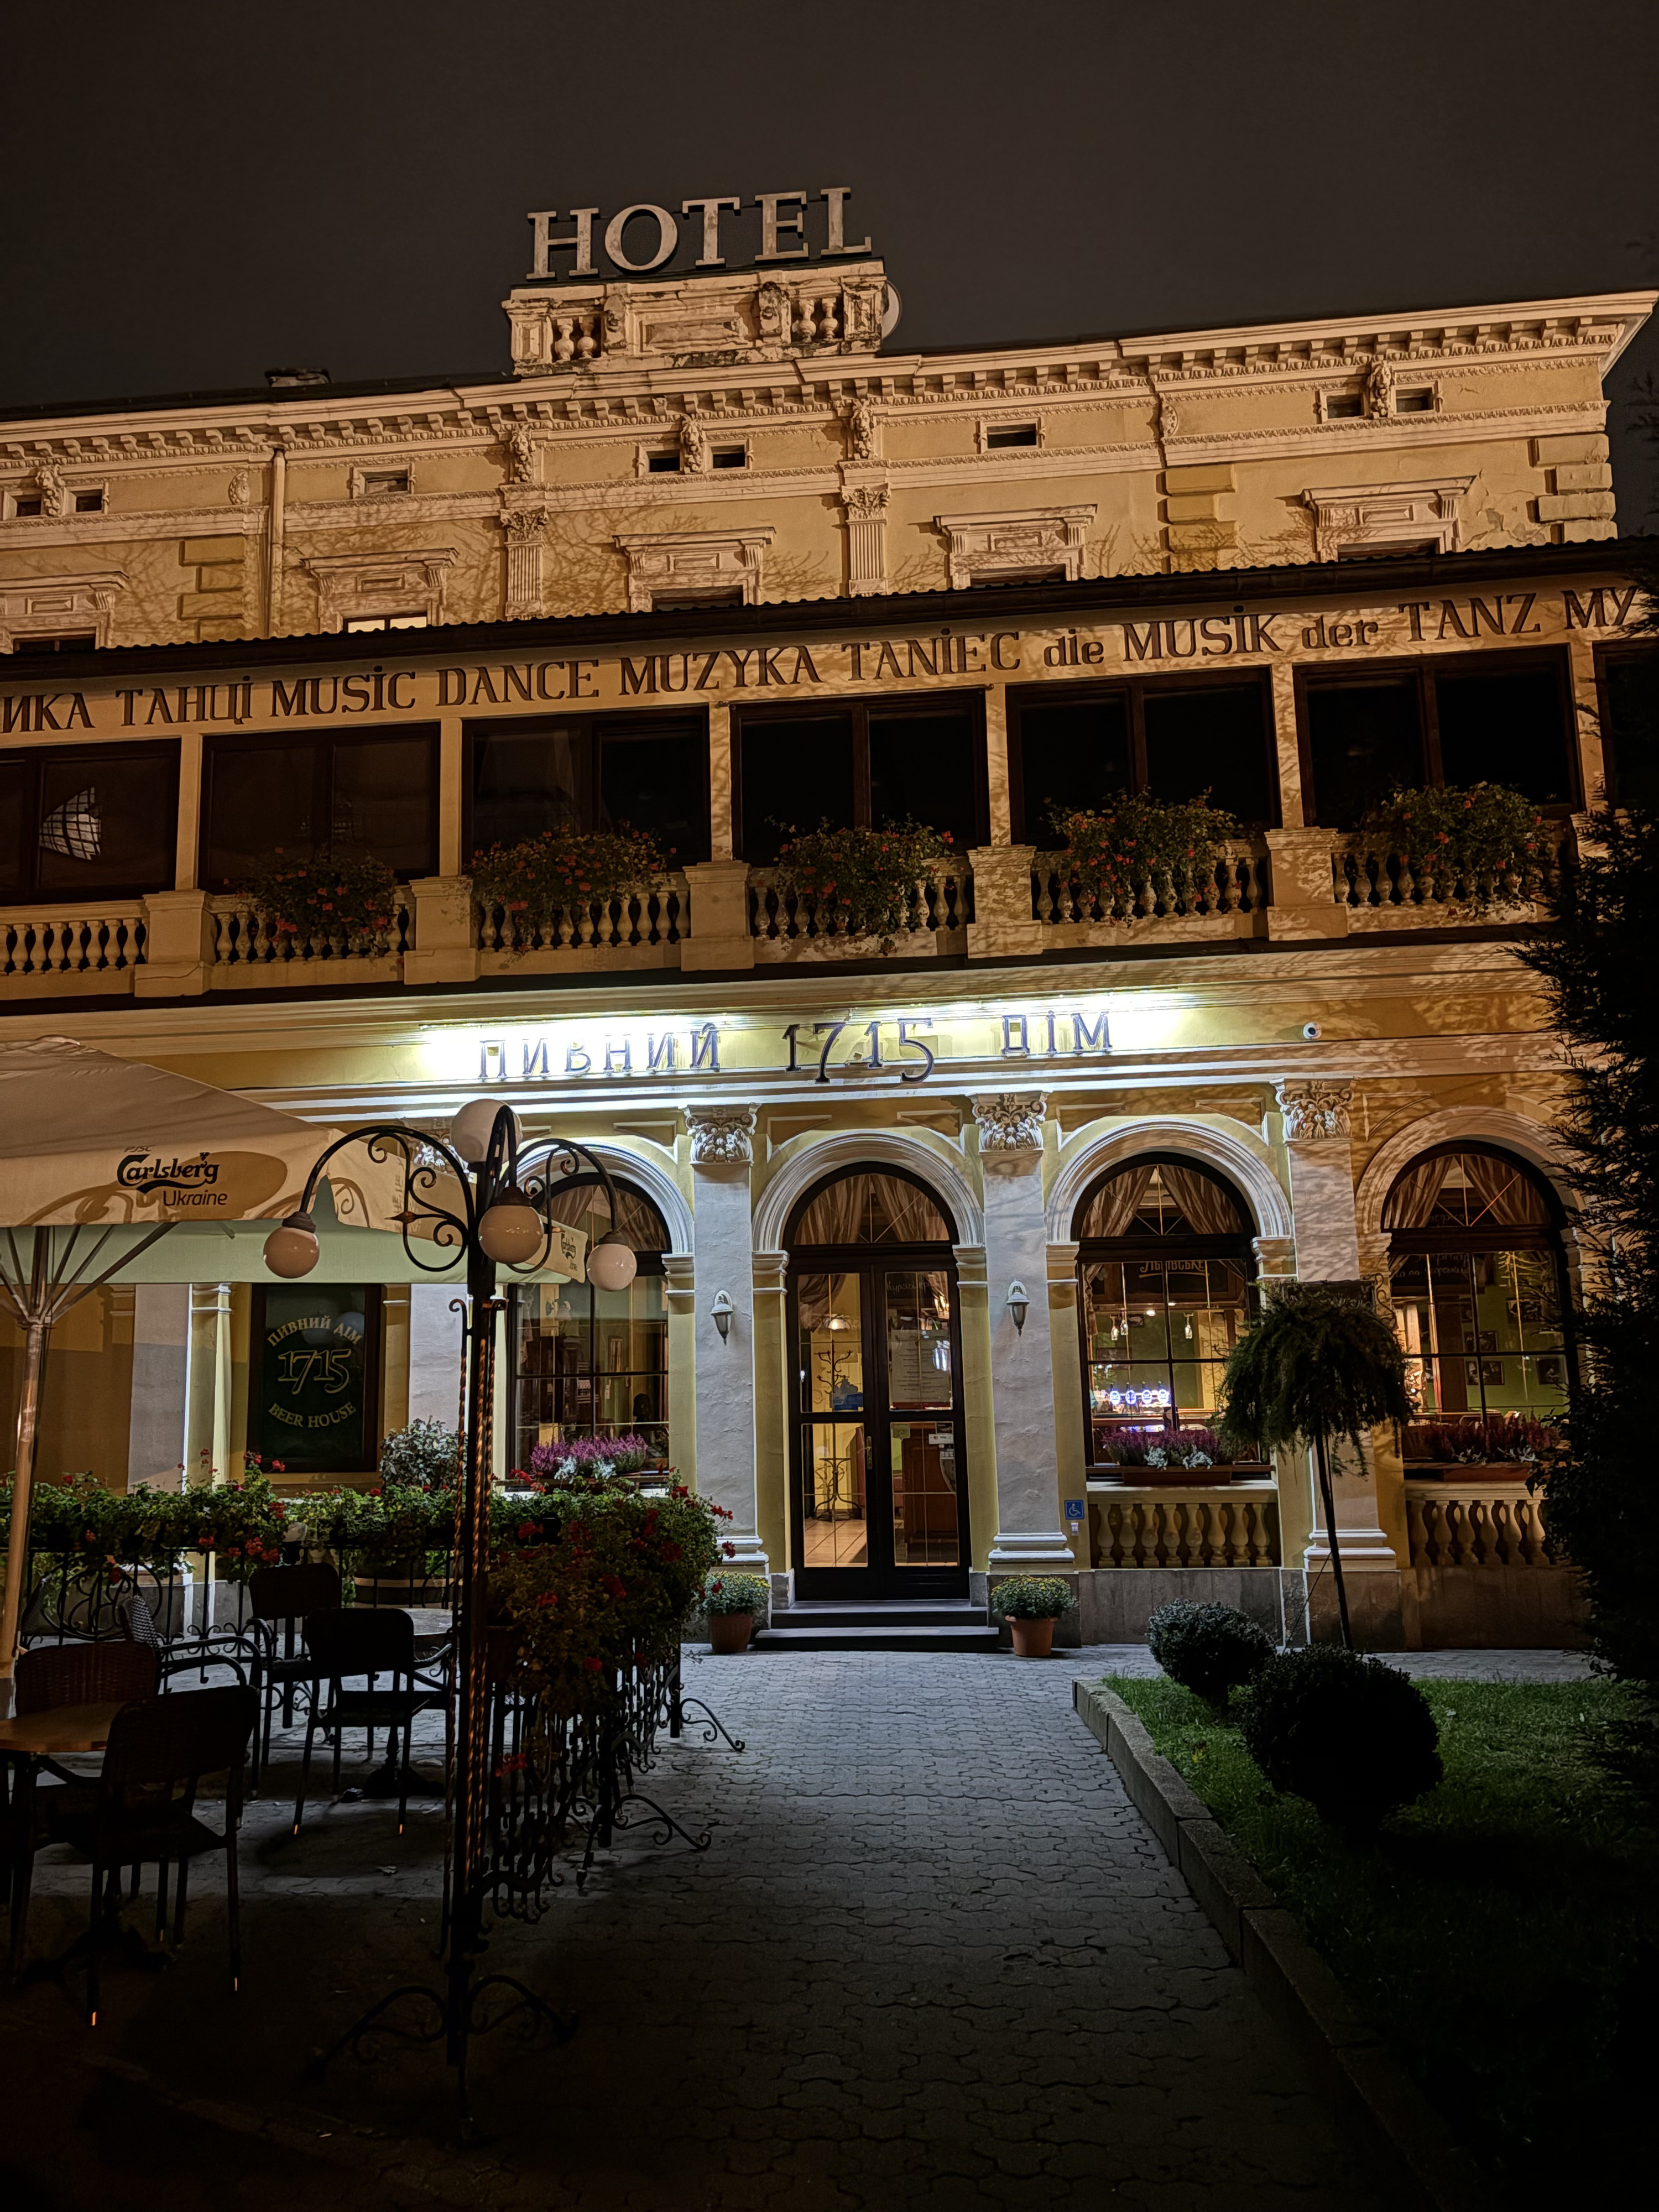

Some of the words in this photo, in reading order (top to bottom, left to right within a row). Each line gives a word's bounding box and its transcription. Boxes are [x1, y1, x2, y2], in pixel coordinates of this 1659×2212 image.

[526, 186, 872, 280] HOTEL
[435, 659, 599, 706] DANCE
[618, 645, 825, 696] MUZYKA
[1044, 629, 1104, 667] die
[1302, 615, 1379, 650] der
[1397, 592, 1541, 642] TANZ
[478, 1022, 720, 1079] ПИВНИЙ
[782, 1018, 935, 1084] 1715
[1000, 1010, 1113, 1056] ДІМ
[123, 1144, 156, 1153] PJSC
[117, 1152, 220, 1188] Carlsberg
[163, 1190, 228, 1207] Ukraine
[267, 1315, 332, 1347] ПИВНИЙ
[278, 1348, 352, 1395] 1715
[268, 1403, 304, 1427] BEER
[307, 1402, 357, 1428] HOUSE
